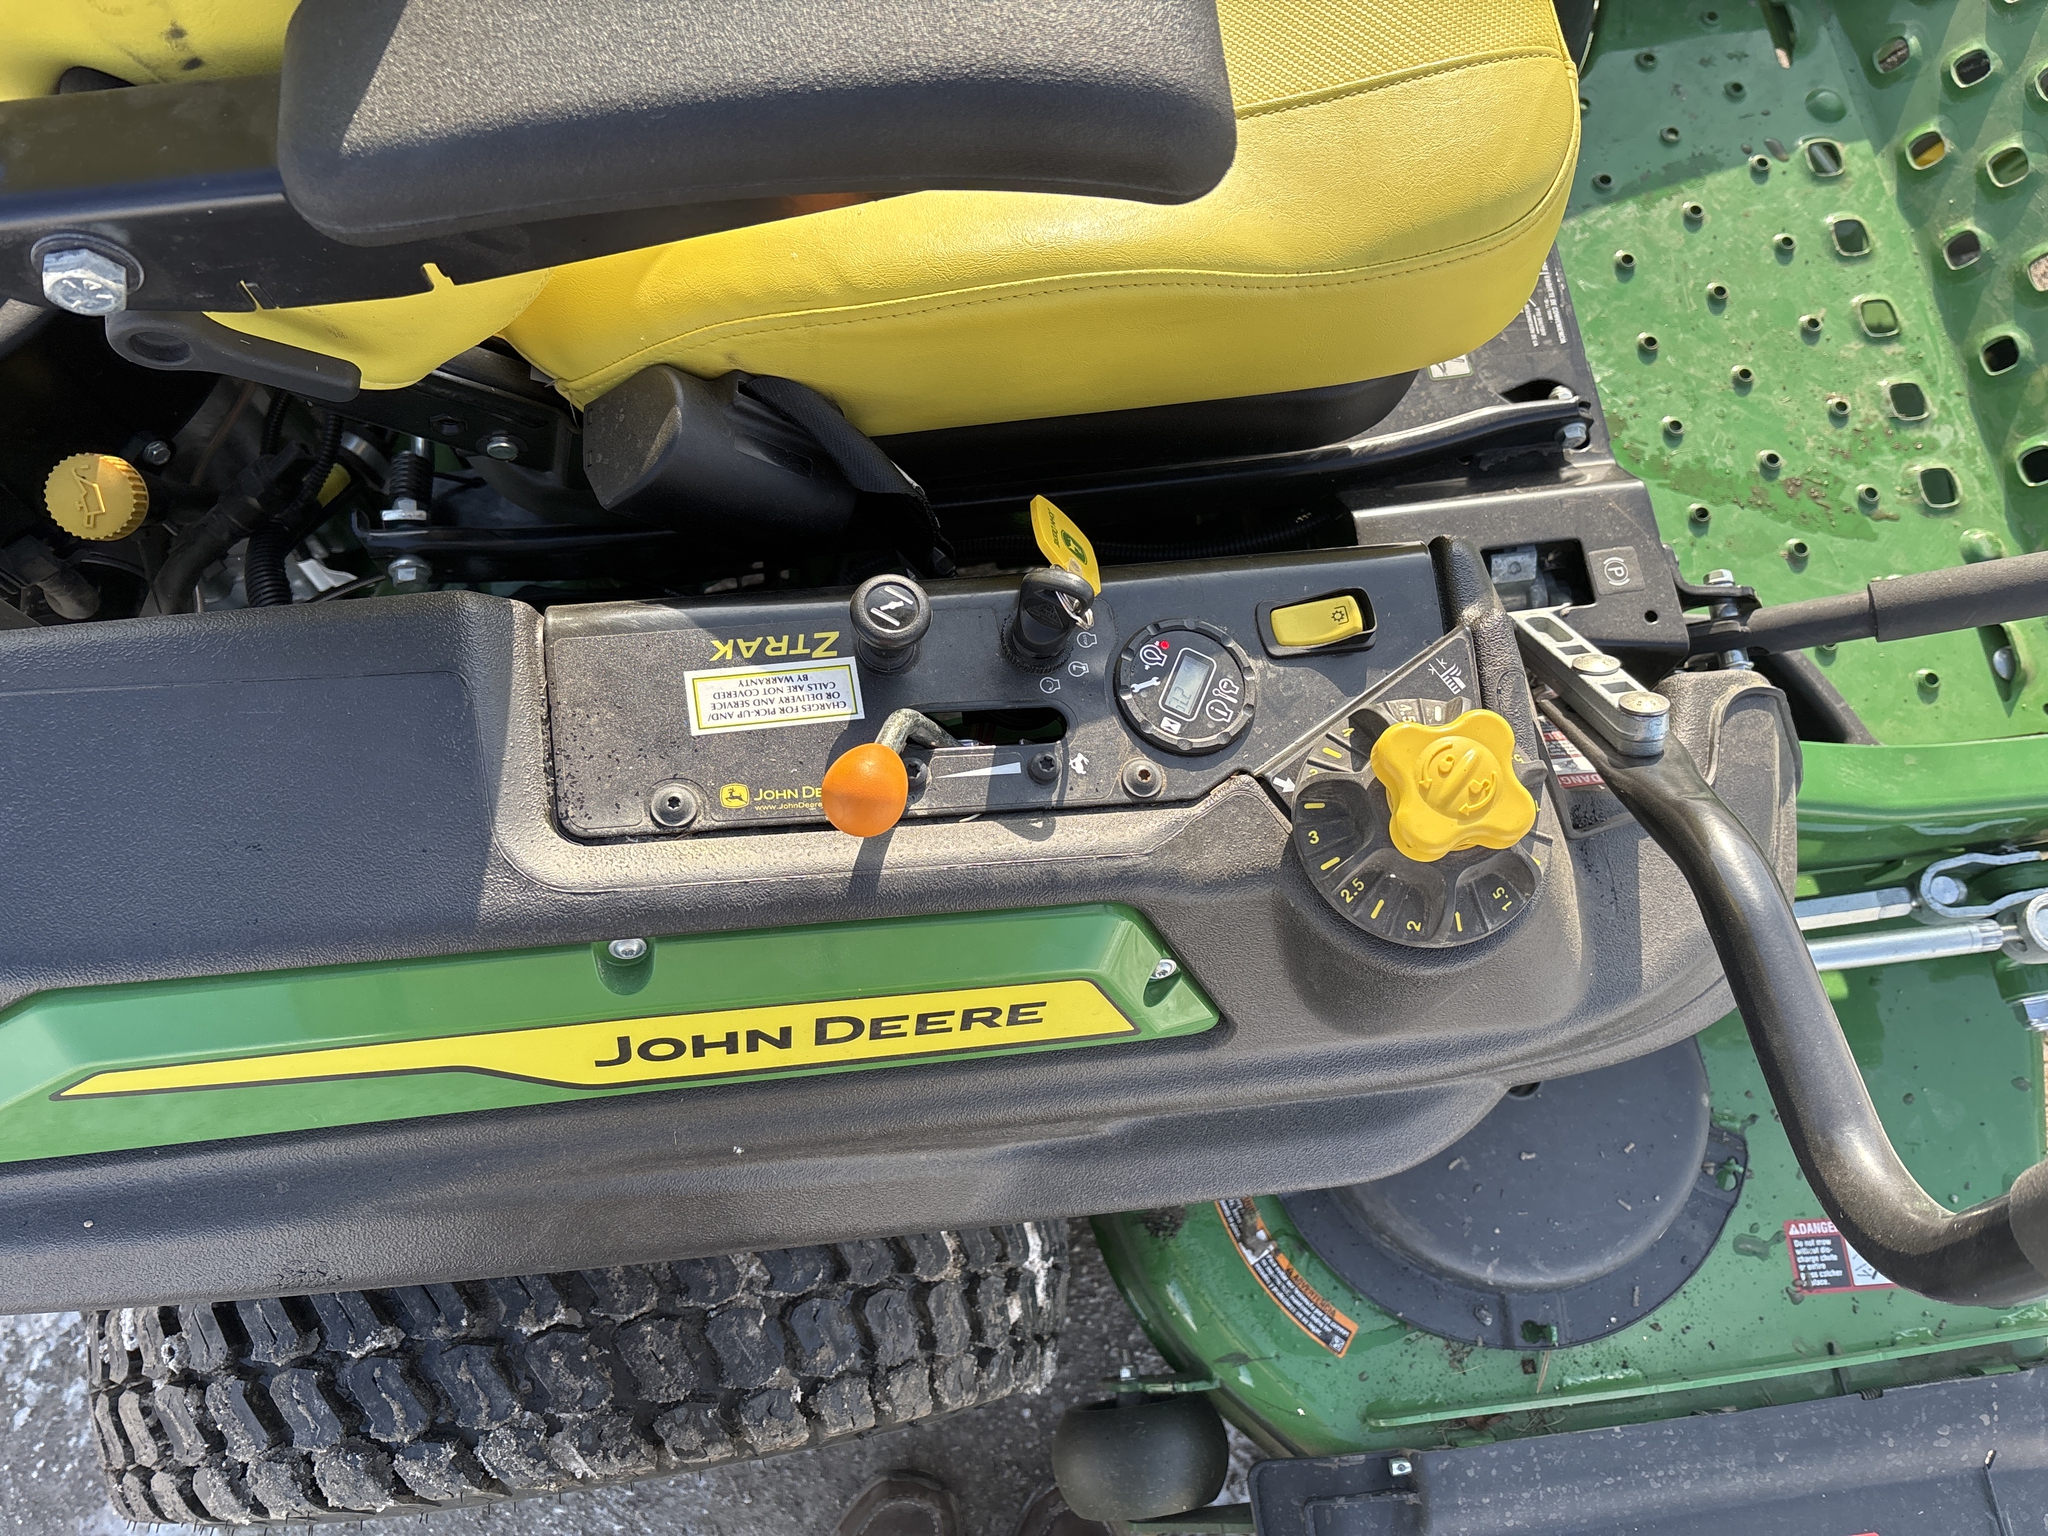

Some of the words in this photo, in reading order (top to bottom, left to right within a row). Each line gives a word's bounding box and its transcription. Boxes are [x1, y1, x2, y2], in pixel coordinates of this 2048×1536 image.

[710, 631, 840, 662] ZTRAK
[738, 675, 794, 687] WARRANTY
[797, 674, 808, 682] BY
[763, 687, 783, 696] NOT
[787, 684, 804, 693] ARE
[808, 682, 836, 691] CALLS
[713, 688, 759, 700] COVERED
[779, 693, 823, 704] DELIVERY
[826, 691, 840, 699] OR
[711, 699, 750, 710] SERVICE
[753, 697, 775, 706] AND
[802, 701, 847, 712] CHARGES
[737, 707, 776, 718] PICK-UP
[779, 705, 799, 714] FOR
[708, 711, 734, 721] AND/
[1559, 774, 1602, 785] DANG
[754, 788, 799, 801] JOHN
[1308, 830, 1320, 844] 3
[1340, 878, 1365, 903] 2.5
[1492, 886, 1512, 912] 1.5
[1406, 920, 1422, 931] 2
[594, 1025, 792, 1068] JOHN
[814, 1001, 1048, 1046] DEERE
[1798, 1221, 1838, 1234] DANGE
